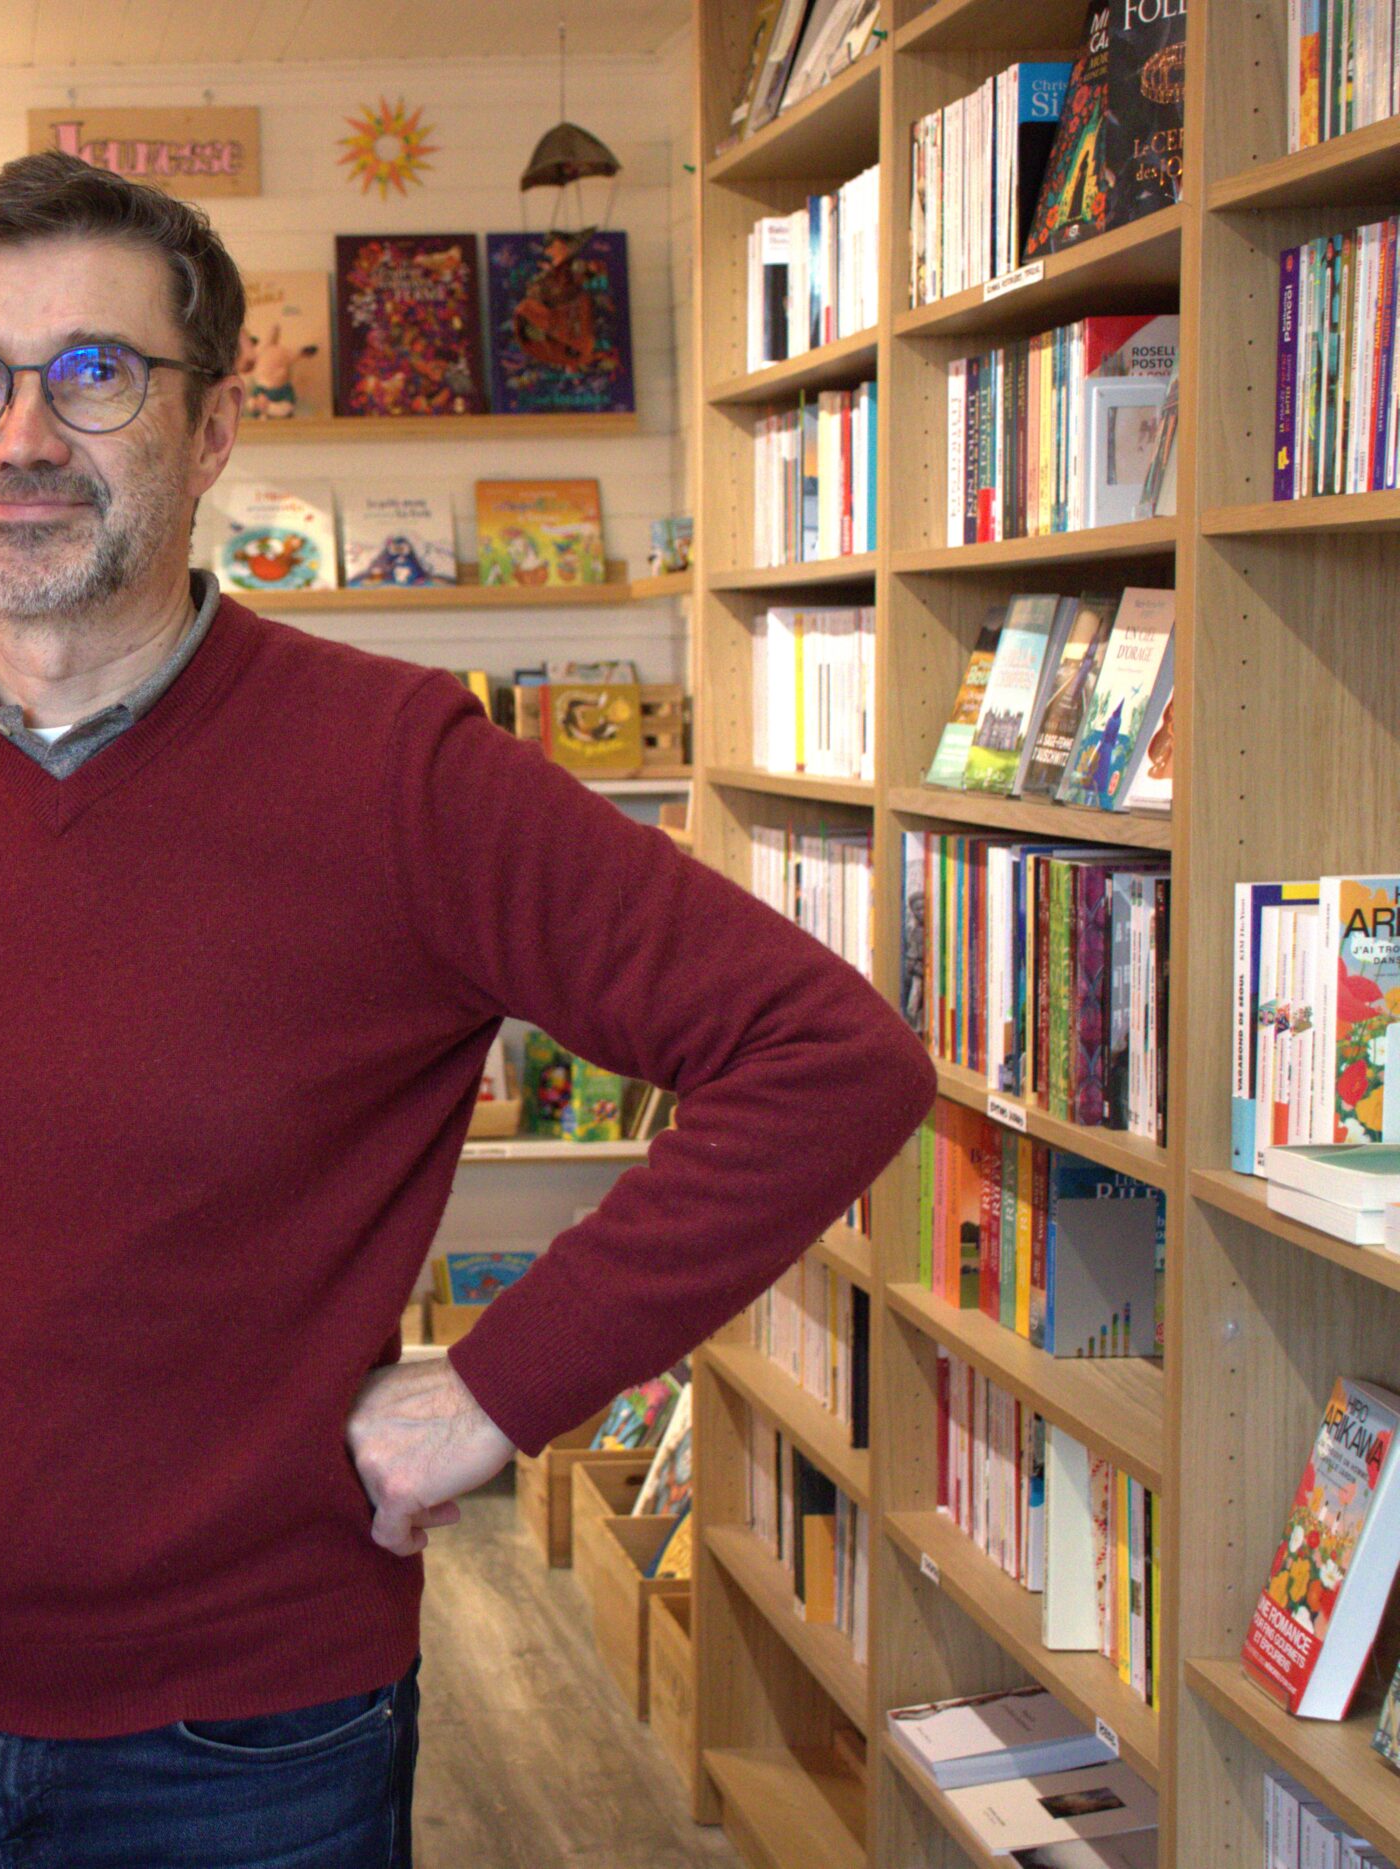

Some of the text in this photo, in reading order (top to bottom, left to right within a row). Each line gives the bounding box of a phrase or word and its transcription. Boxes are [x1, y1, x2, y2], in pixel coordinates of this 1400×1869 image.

[1123, 0, 1188, 31] FOLL
[1031, 78, 1068, 93] Chris
[1030, 93, 1060, 118] Si
[1131, 346, 1176, 357] ROSELL
[1131, 358, 1174, 369] POSTO
[1352, 945, 1400, 955] J'AI TRO
[1321, 1404, 1384, 1472] ARIKAWA
[1268, 1605, 1313, 1656] ROMANCE
